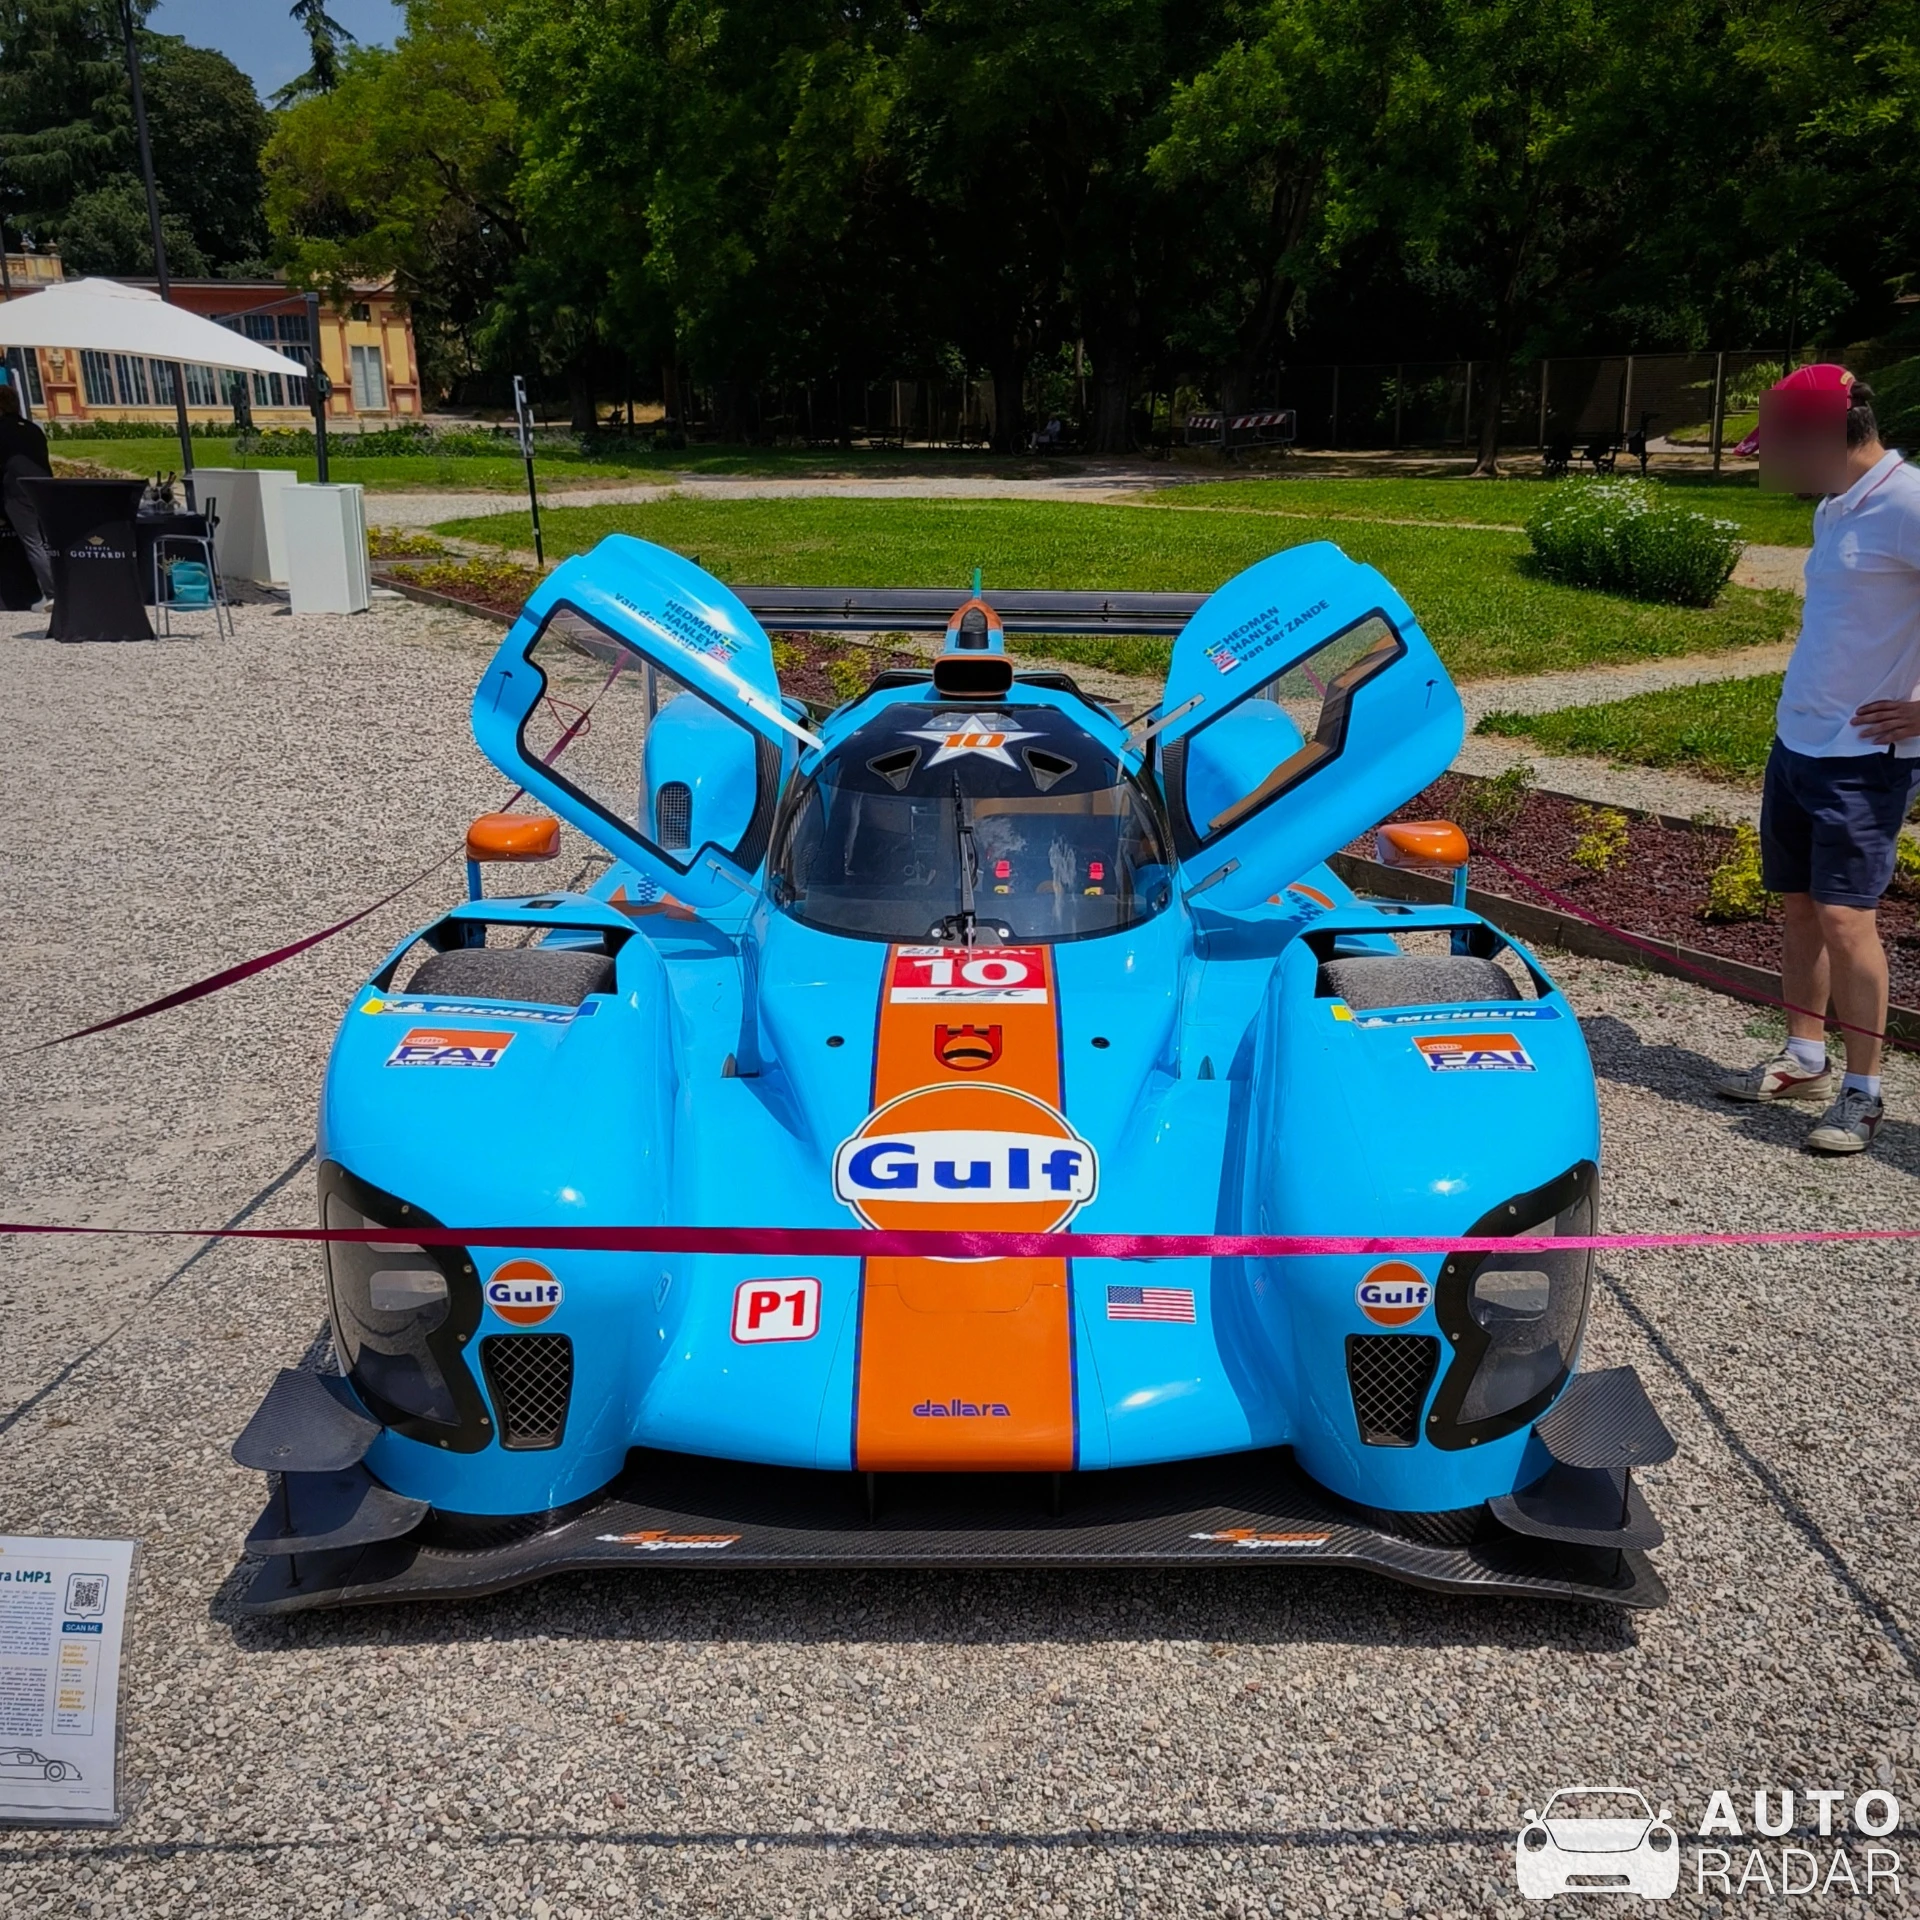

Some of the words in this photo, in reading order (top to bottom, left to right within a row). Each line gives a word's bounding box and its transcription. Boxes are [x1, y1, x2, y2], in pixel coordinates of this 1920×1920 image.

[615, 593, 636, 611] van
[665, 600, 722, 639] HEDMAN
[1222, 606, 1280, 645] HEDMAN
[663, 611, 716, 647] HANLEY
[1230, 617, 1281, 653] HANLEY
[1241, 645, 1264, 662] van
[1265, 630, 1285, 647] der
[1284, 599, 1330, 633] ZANDE
[943, 733, 1007, 748] 10
[913, 958, 1028, 986] 10
[432, 1005, 575, 1021] MICHELIN
[1395, 1010, 1537, 1023] MICHELIN
[396, 1046, 498, 1060] FAI
[1429, 1051, 1527, 1065] FAI
[848, 1142, 1082, 1192] Gulf
[489, 1284, 559, 1303] Gulf
[1360, 1285, 1429, 1304] Gulf
[748, 1290, 806, 1329] P1
[913, 1399, 1011, 1417] dallara
[634, 1540, 734, 1551] Speed
[1233, 1538, 1328, 1549] Speed
[16, 1570, 52, 1583] LMP1
[66, 1623, 86, 1631] SCAN
[87, 1624, 99, 1632] ME
